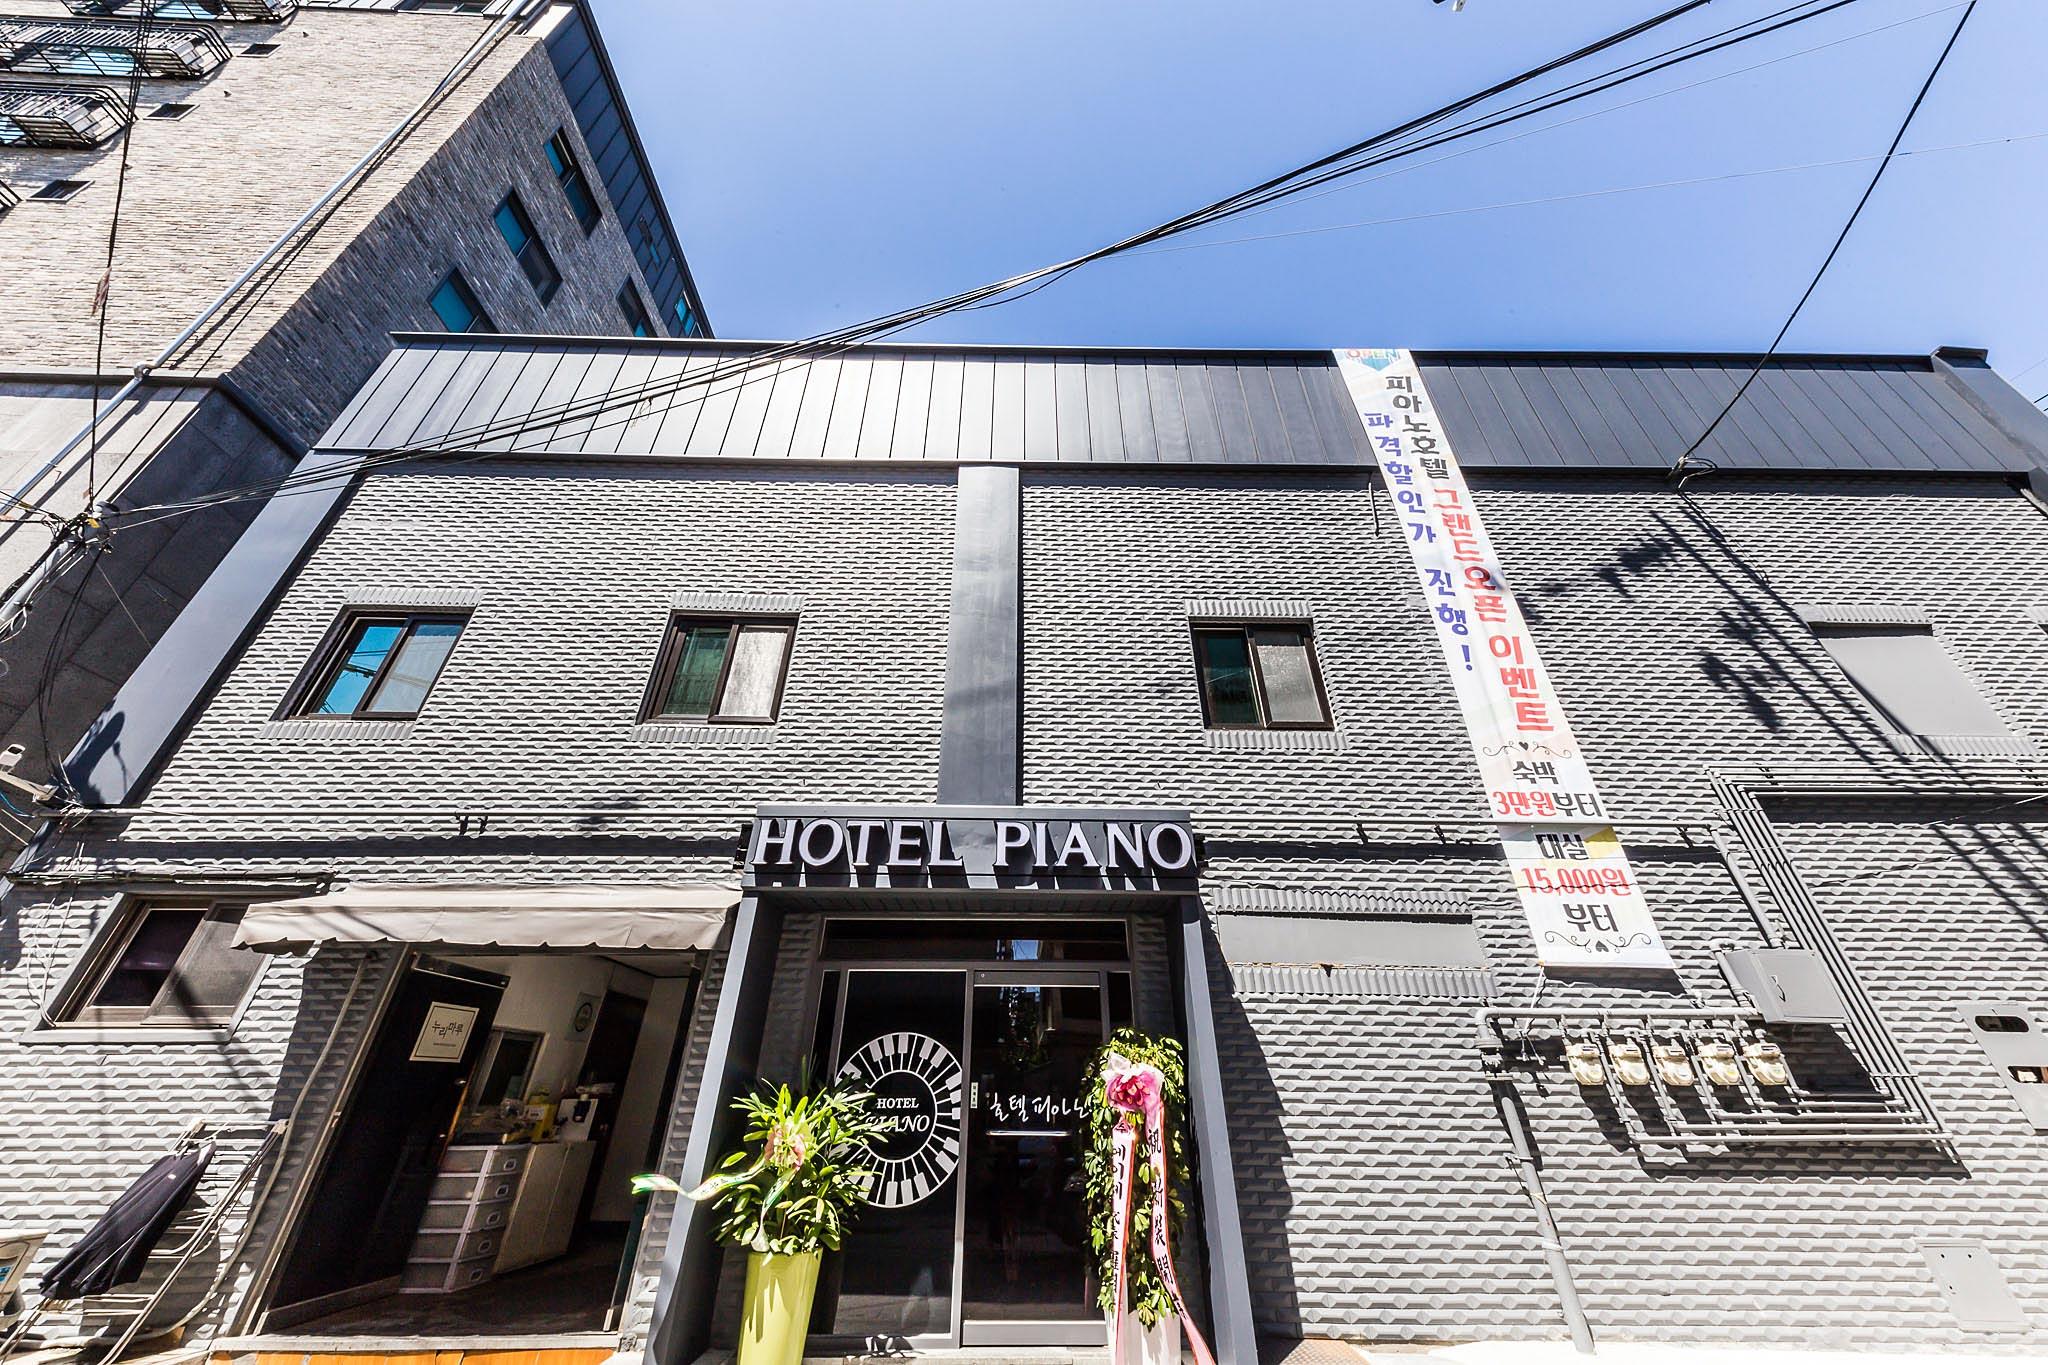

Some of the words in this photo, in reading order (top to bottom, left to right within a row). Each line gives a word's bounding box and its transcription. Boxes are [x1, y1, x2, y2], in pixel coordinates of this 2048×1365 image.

[1489, 636, 1554, 732] 이벤트
[1513, 761, 1560, 785] 숙박
[1492, 791, 1603, 817] 3만원부터
[751, 818, 963, 867] HOTEL
[994, 821, 1193, 870] PIANO
[1535, 832, 1590, 860] 대실
[1521, 868, 1632, 896] 15,000원
[1563, 904, 1619, 932] 부터
[876, 1097, 919, 1109] HOTEL
